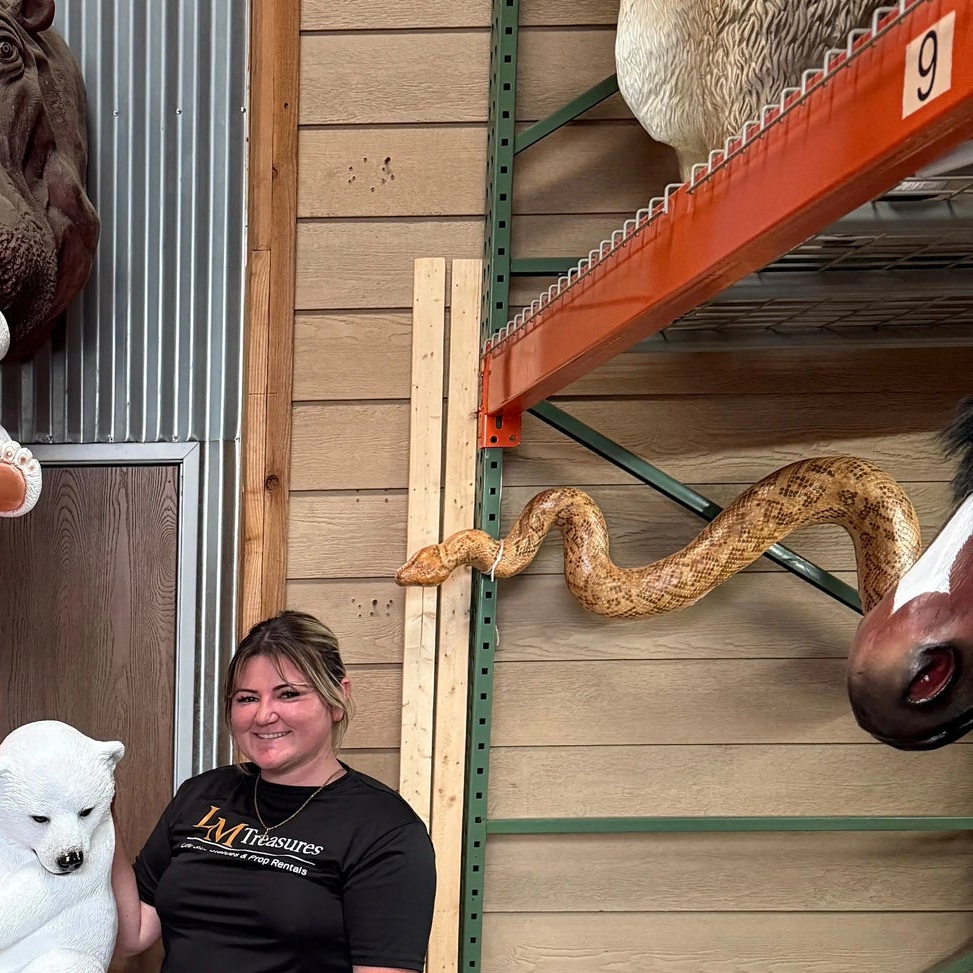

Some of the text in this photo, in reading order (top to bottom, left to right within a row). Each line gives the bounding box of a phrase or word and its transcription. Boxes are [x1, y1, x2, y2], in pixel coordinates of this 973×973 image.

[917, 30, 938, 102] 9
[193, 805, 324, 855] LM Treasures
[248, 854, 270, 865] Prop
[270, 858, 308, 876] Rentals
